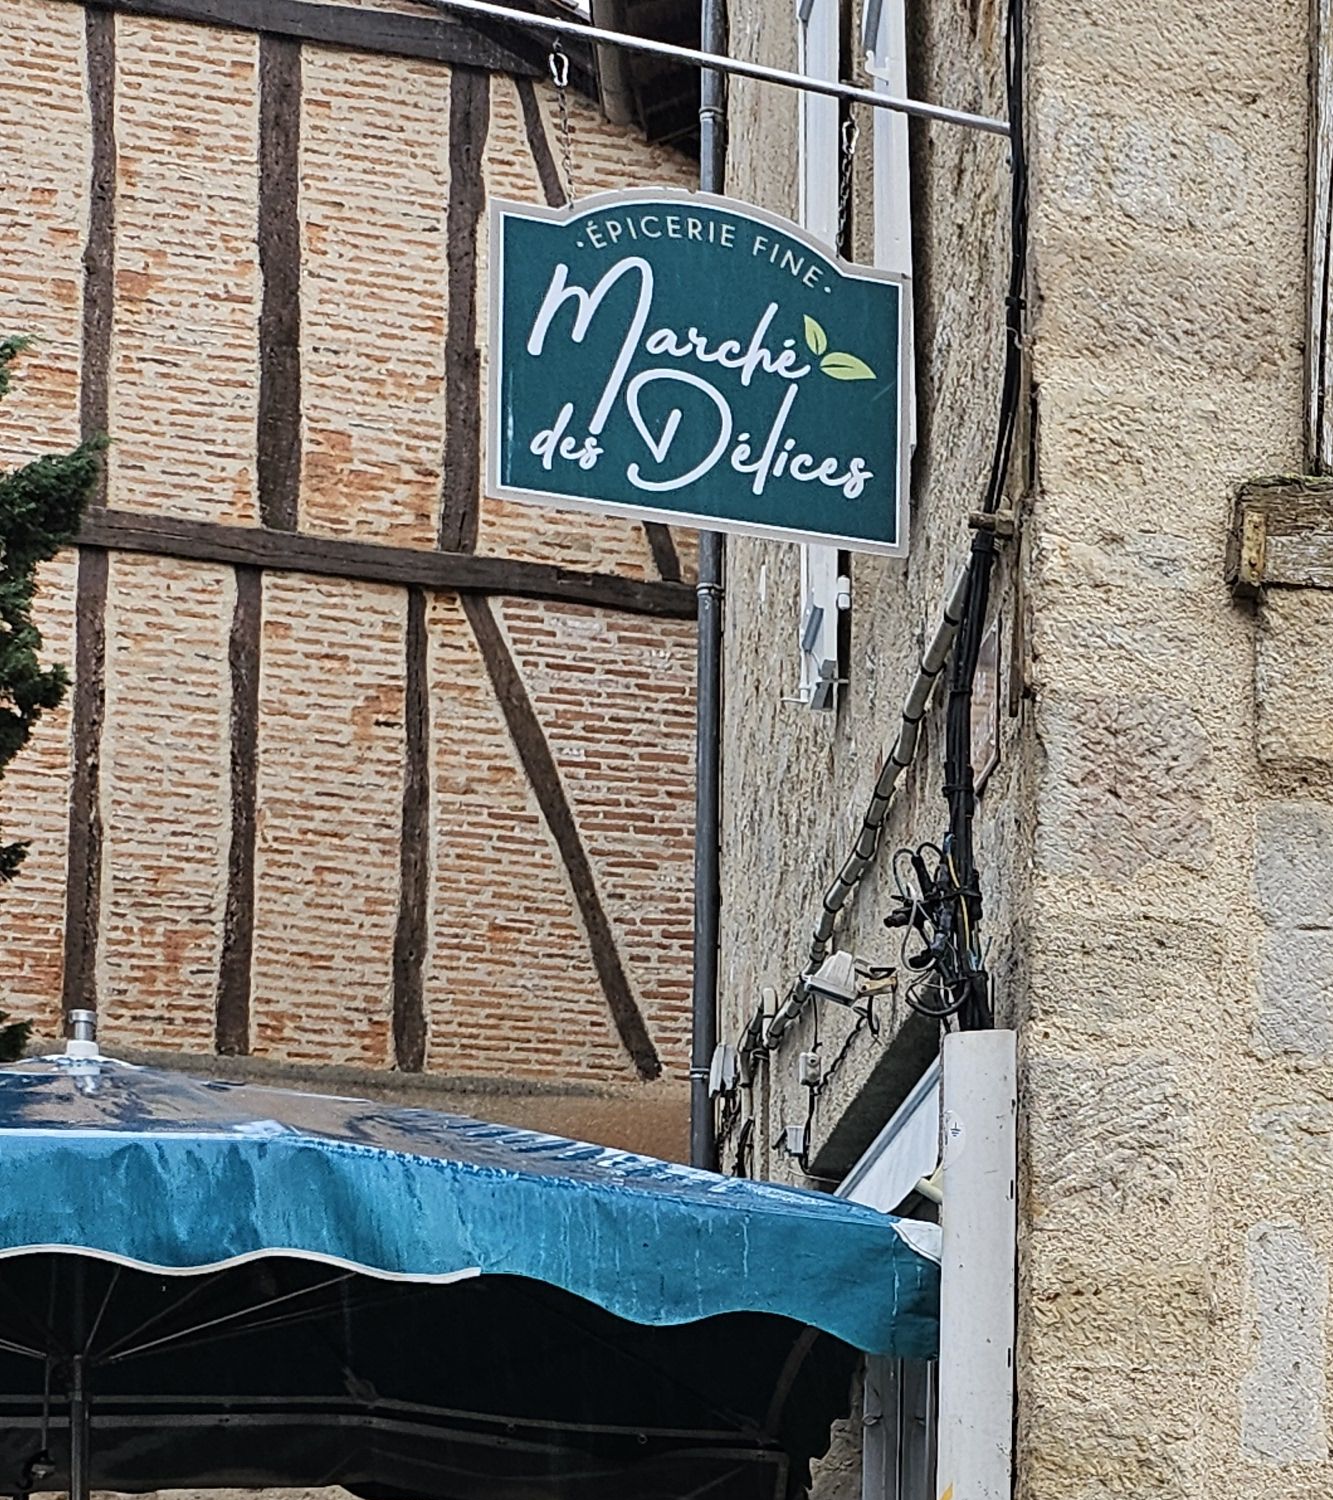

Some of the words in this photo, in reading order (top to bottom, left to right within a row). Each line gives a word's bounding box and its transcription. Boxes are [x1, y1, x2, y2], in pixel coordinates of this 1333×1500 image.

[584, 215, 736, 250] ÉPICERIE
[753, 236, 824, 289] FINE
[527, 256, 811, 434] Marché
[530, 403, 604, 471] des
[626, 368, 875, 500] Délices
